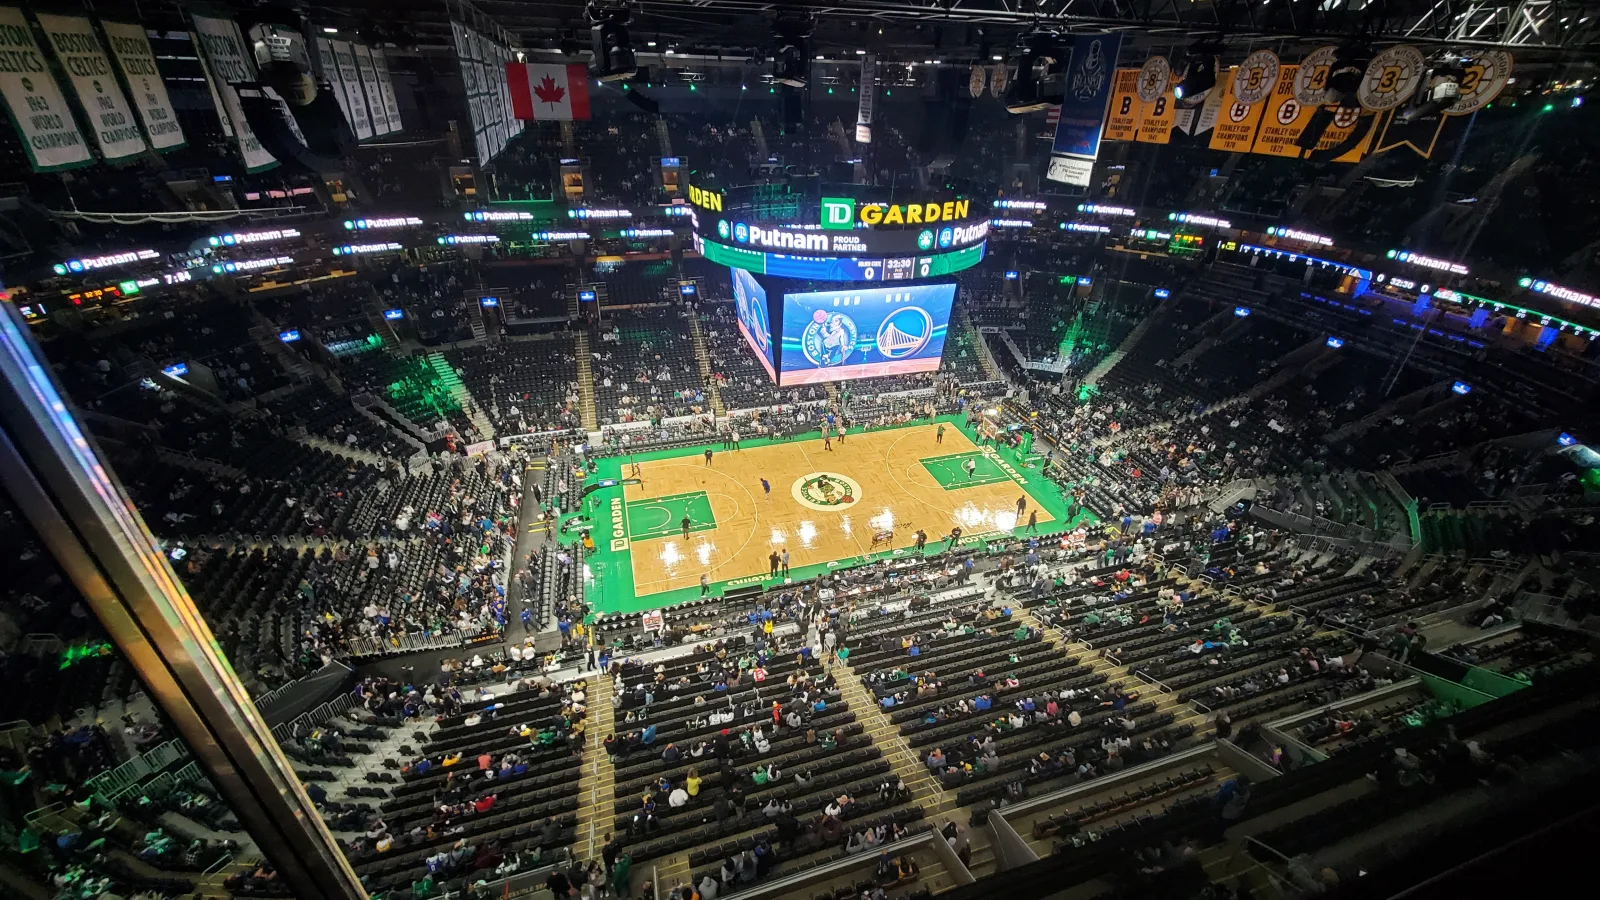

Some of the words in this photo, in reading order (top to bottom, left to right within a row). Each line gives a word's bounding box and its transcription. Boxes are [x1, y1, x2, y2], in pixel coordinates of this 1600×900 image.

[0, 24, 33, 47] STON
[50, 32, 102, 53] BOSTON
[112, 36, 150, 55] BOSTON
[0, 51, 44, 73] ELTICS
[67, 56, 107, 76] CELTICS
[1302, 49, 1329, 70] ROBERT
[1366, 52, 1391, 76] LIONEL
[1394, 49, 1420, 76] HITCHMAN
[1494, 51, 1508, 79] SHORE
[123, 58, 156, 76] CELTICS
[214, 59, 247, 81] CELTICS
[1120, 71, 1140, 82] BOST
[1148, 74, 1157, 86] 8
[1249, 72, 1260, 86] 5
[1313, 70, 1324, 85] 4
[1381, 71, 1396, 88] 3
[1460, 71, 1478, 89] 2
[1119, 82, 1137, 93] BRUIN
[25, 96, 49, 112] 1963
[1120, 96, 1132, 115] B
[1153, 97, 1166, 116] B
[1234, 104, 1245, 117] B
[147, 108, 168, 121] WORLD
[1282, 104, 1295, 120] B
[1341, 107, 1354, 121] B
[29, 114, 63, 131] WORLD
[100, 112, 126, 127] WORLD
[1144, 118, 1160, 126] STANLEY
[101, 126, 140, 144] CHAMPIONS
[149, 121, 179, 135] CHAMPIONS
[1110, 124, 1132, 132] CHAMPIONS
[1141, 126, 1167, 134] CHAMPIONS
[1220, 124, 1239, 132] STANLEY
[1264, 126, 1288, 135] STANLEY
[1288, 128, 1300, 137] CUP
[1322, 130, 1348, 139] TANLEY
[32, 131, 80, 150] CHAMPION
[1216, 133, 1248, 141] CHAMPIONS
[1262, 136, 1298, 146] CHAMPIONS
[1270, 145, 1284, 153] 1972
[688, 184, 722, 212] RDEN
[1007, 201, 1034, 209] Putnam
[483, 212, 519, 221] Putnam
[586, 210, 618, 218] Putnam
[824, 203, 851, 223] TD
[860, 200, 969, 225] GARDEN
[1093, 205, 1123, 215] Putnam
[365, 218, 406, 228] Putnam
[1185, 214, 1218, 226] Putnam
[635, 229, 662, 237] Putnam
[953, 220, 989, 245] Putnam
[1073, 223, 1100, 232] Putnam
[234, 230, 282, 244] Putnam
[454, 235, 486, 244] Putnam
[548, 232, 577, 240] Putnam
[750, 226, 828, 250] Putnam
[833, 235, 859, 244] PROUD
[1285, 229, 1320, 243] Putnam
[351, 243, 388, 253] Putnam
[833, 243, 867, 252] PARTNER
[81, 252, 138, 270] Putnam
[235, 258, 277, 271] Putnam
[887, 259, 911, 269] 32:30
[1407, 254, 1450, 271] Putnam
[864, 267, 874, 279] 0
[921, 264, 930, 277] 0
[137, 278, 159, 288] Bank
[1376, 273, 1385, 282] 0
[1390, 277, 1414, 290] 32:30
[1420, 284, 1429, 293] 0
[1543, 283, 1592, 305] Putnam
[806, 323, 820, 357] BOSTON
[990, 453, 1029, 484] GARDEN
[610, 497, 624, 538] GARDEN
